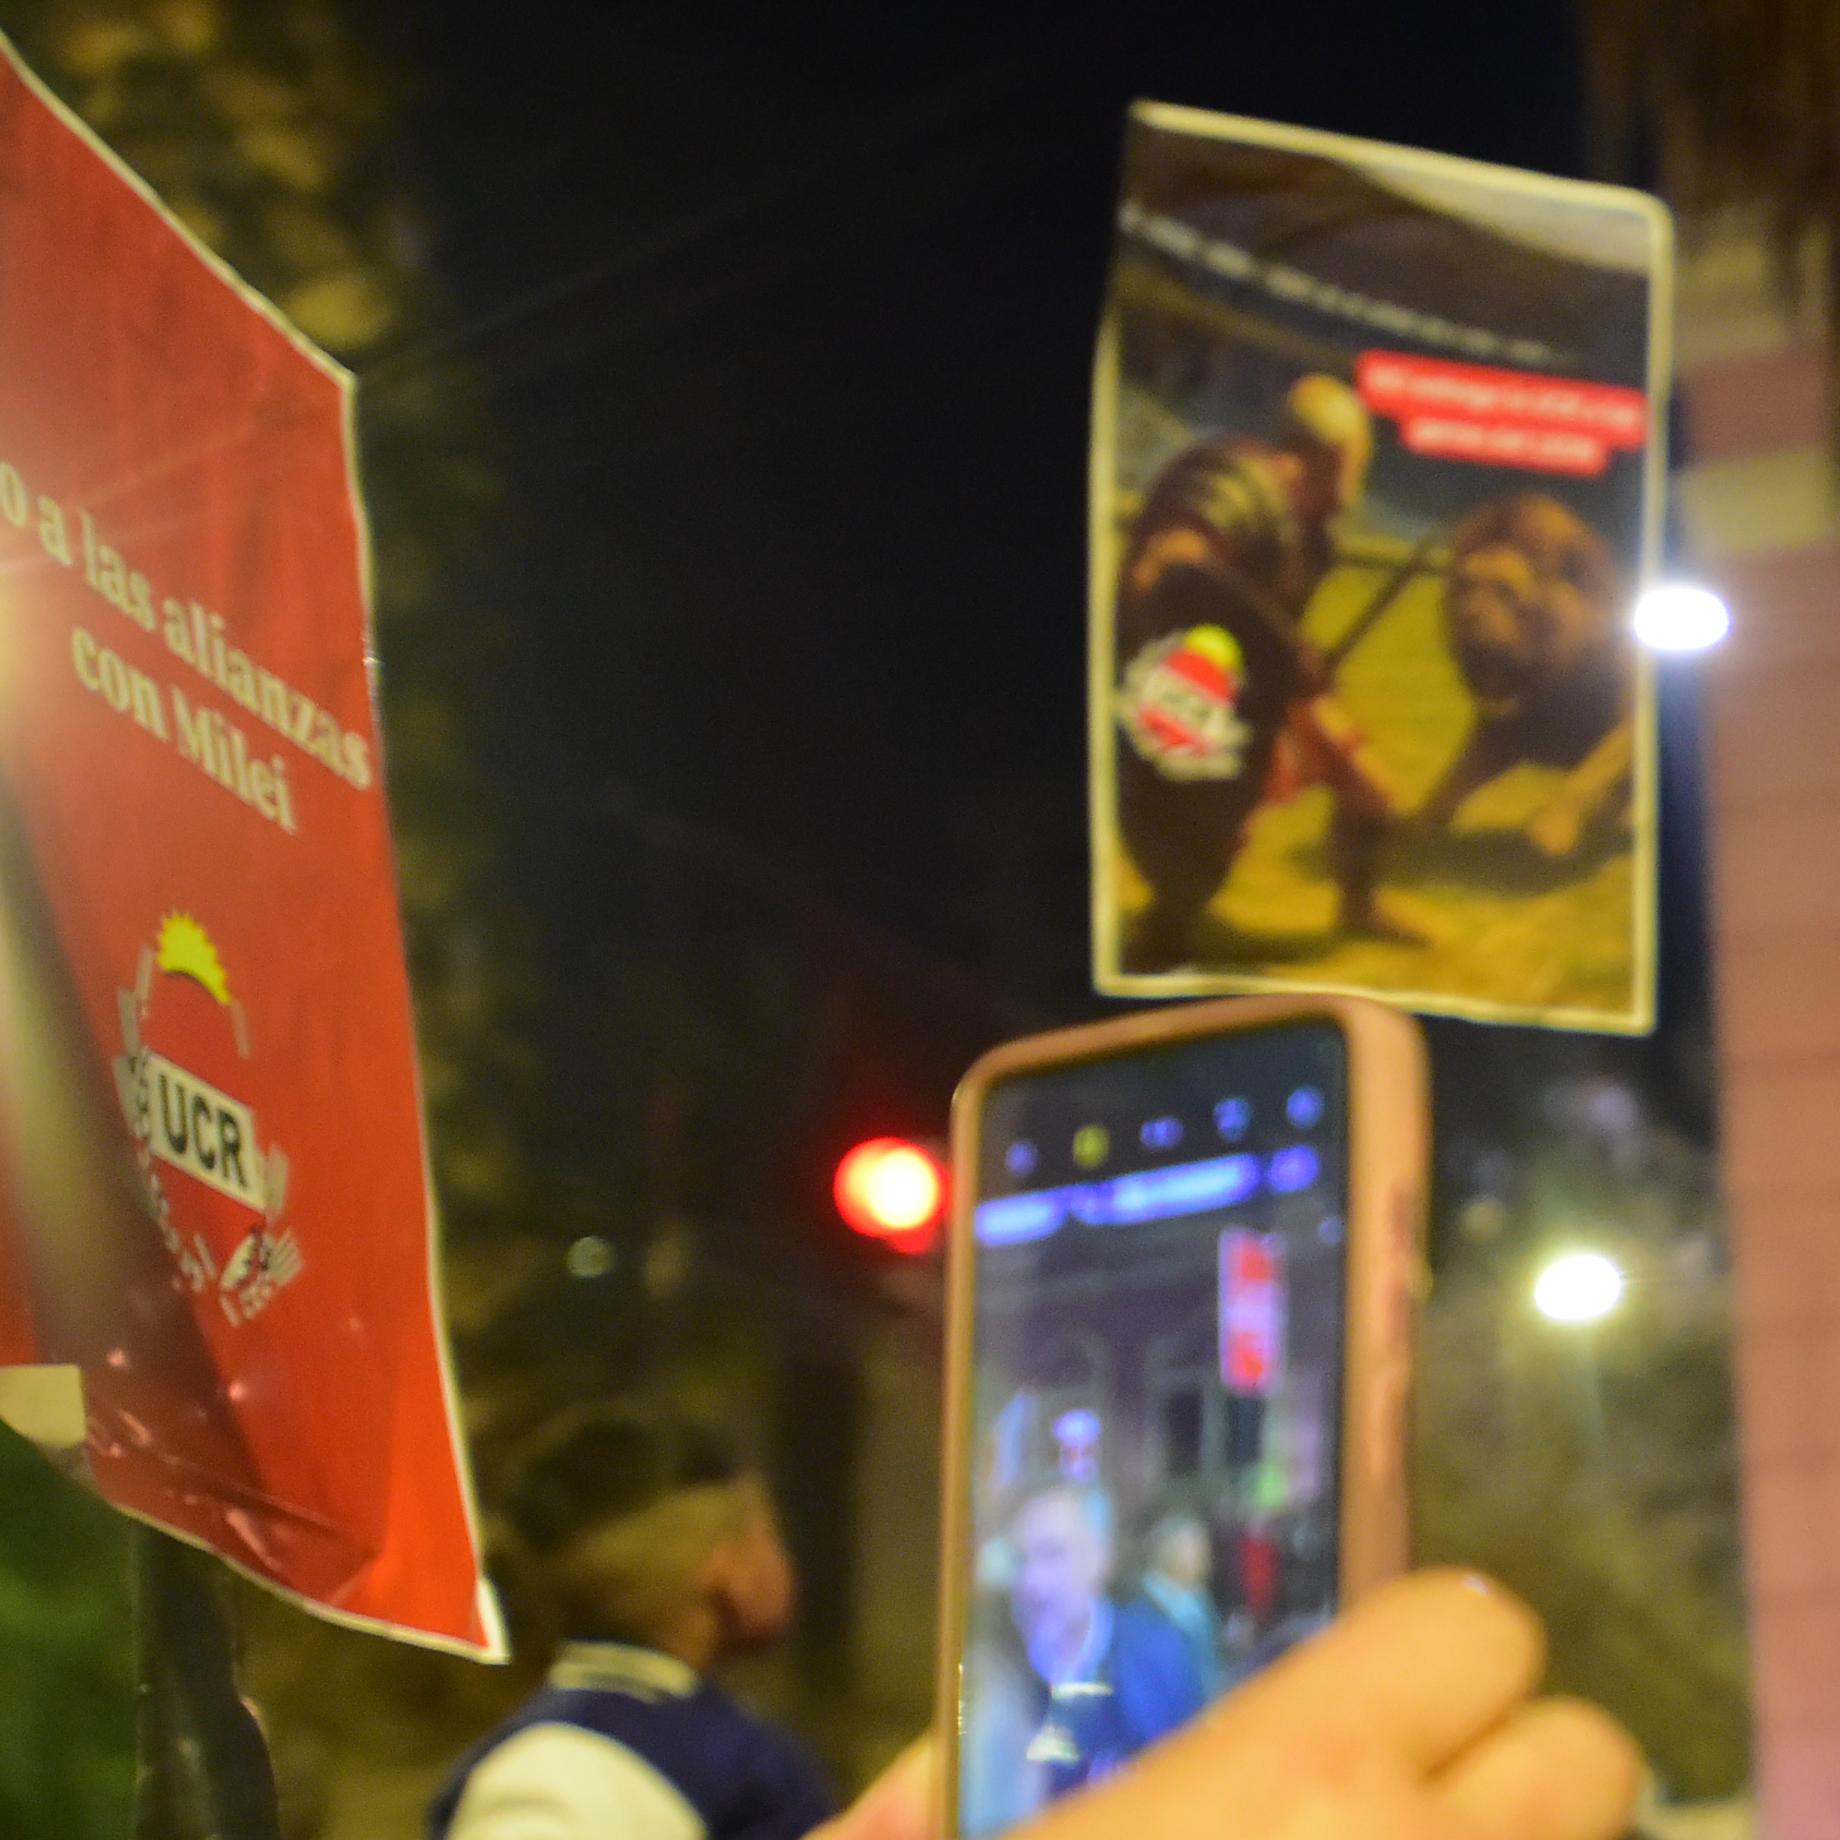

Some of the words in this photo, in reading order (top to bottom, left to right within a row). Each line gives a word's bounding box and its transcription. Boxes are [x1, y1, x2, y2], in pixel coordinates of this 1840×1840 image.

[38, 494, 74, 568] a
[79, 505, 157, 633] las
[161, 597, 372, 793] alianzas
[70, 626, 169, 744] con
[170, 683, 297, 839] Milei
[157, 1072, 249, 1191] UCR
